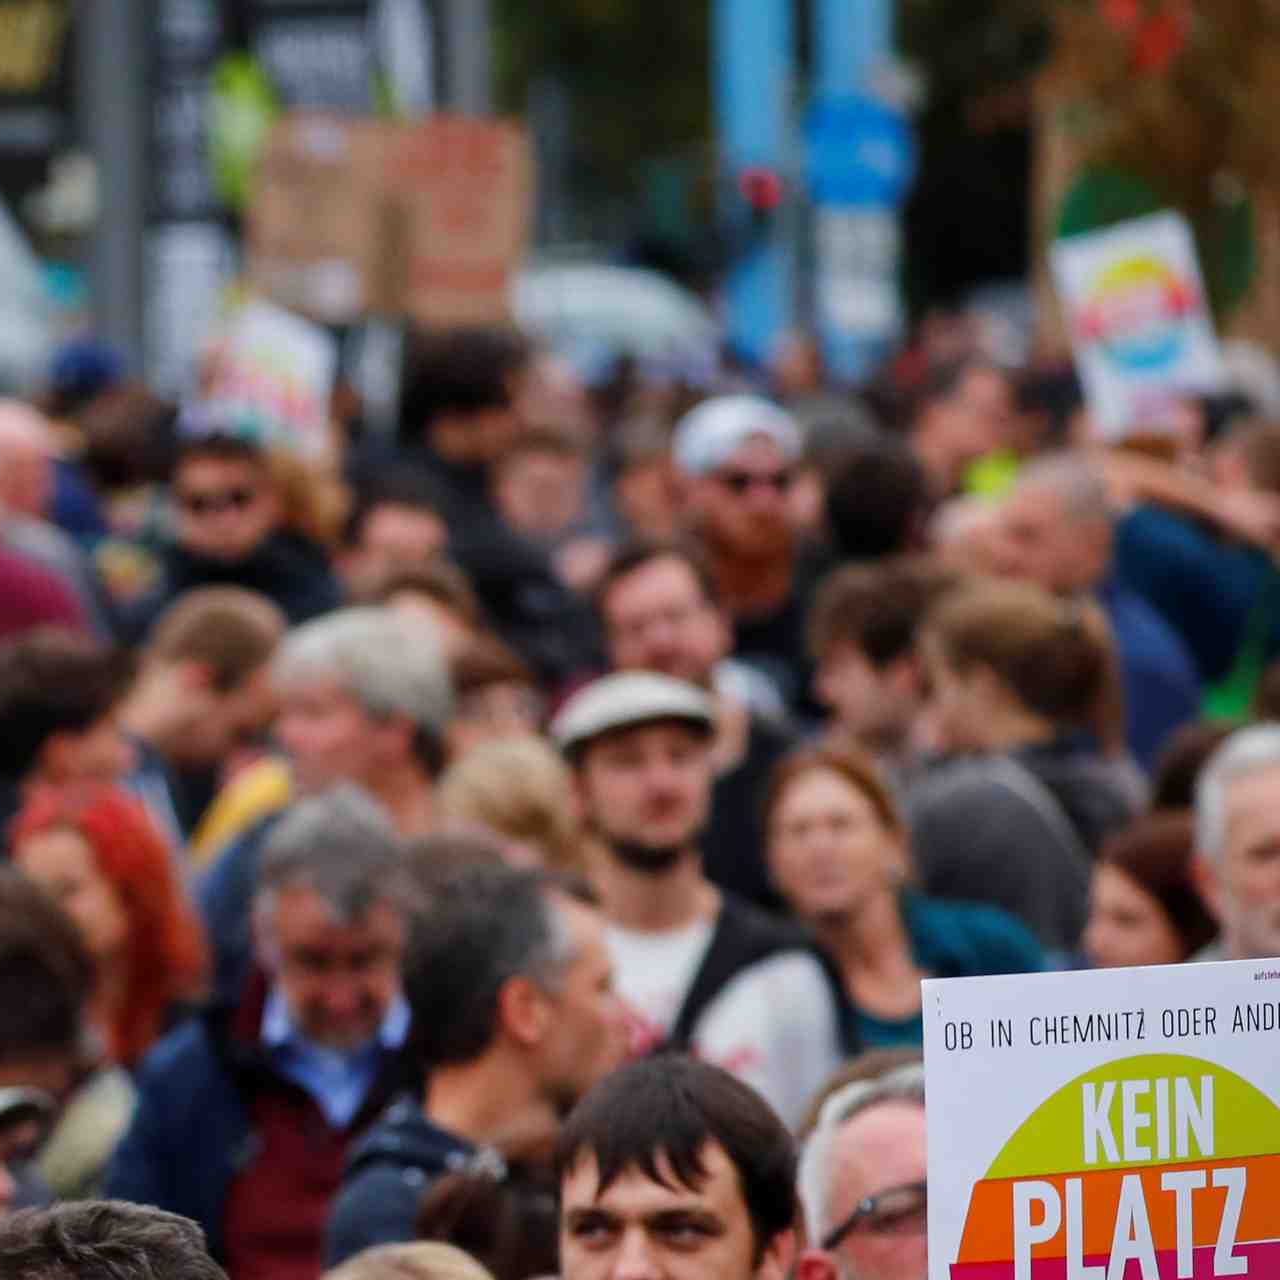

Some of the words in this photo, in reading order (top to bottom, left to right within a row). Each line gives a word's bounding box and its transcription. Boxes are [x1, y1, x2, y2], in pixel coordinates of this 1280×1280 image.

[944, 1021, 973, 1051] OB
[990, 1018, 1013, 1049] IN
[1029, 1010, 1146, 1047] CHEMNITZ
[1161, 1006, 1217, 1038] ODER
[1232, 1002, 1280, 1033] AND
[1082, 1074, 1216, 1165] KEIN
